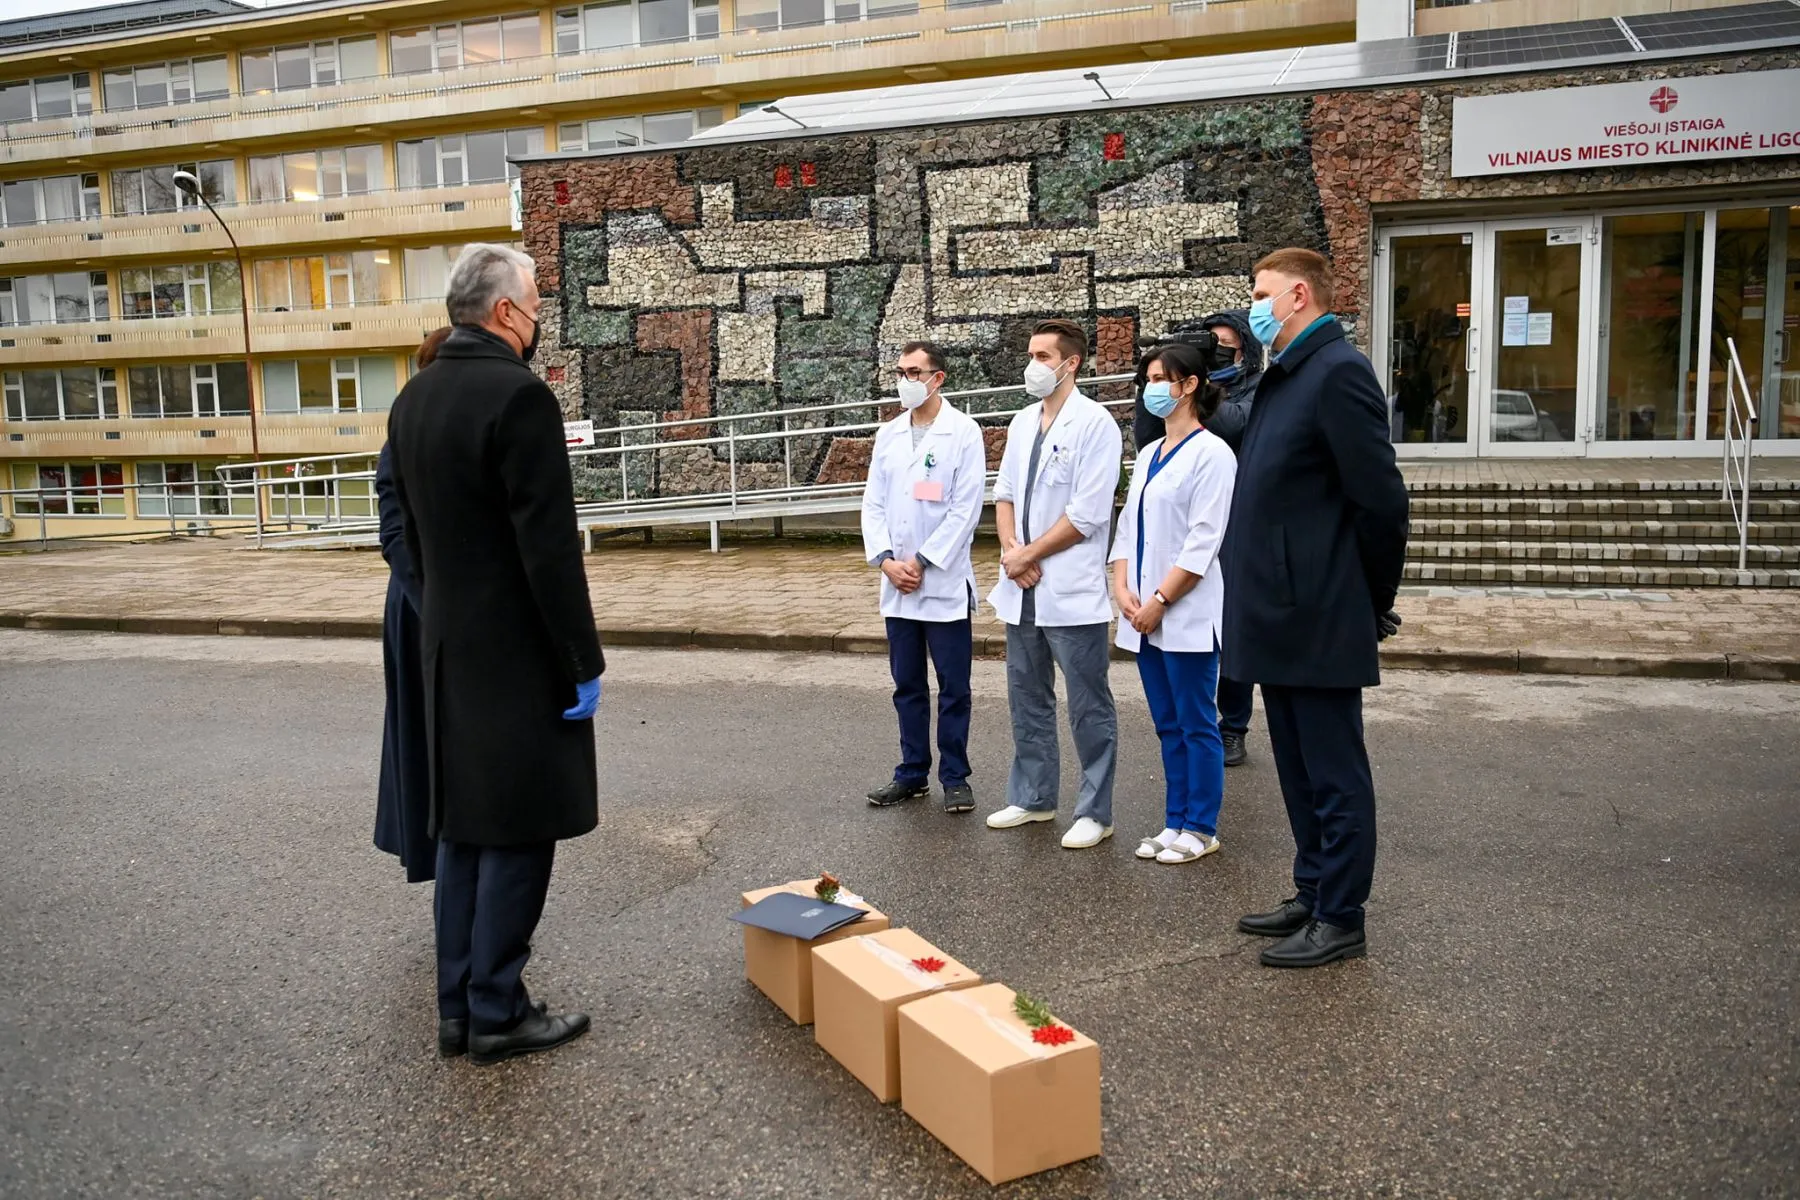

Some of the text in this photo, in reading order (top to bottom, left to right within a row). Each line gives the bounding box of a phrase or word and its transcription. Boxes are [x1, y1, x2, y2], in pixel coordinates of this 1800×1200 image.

[1603, 118, 1726, 137] VIEŠOJI ĮSTAIGA
[1488, 148, 1573, 167] VILNIAUS
[1577, 142, 1650, 161] MIESTO
[1655, 131, 1753, 156] KLINIKINĖ
